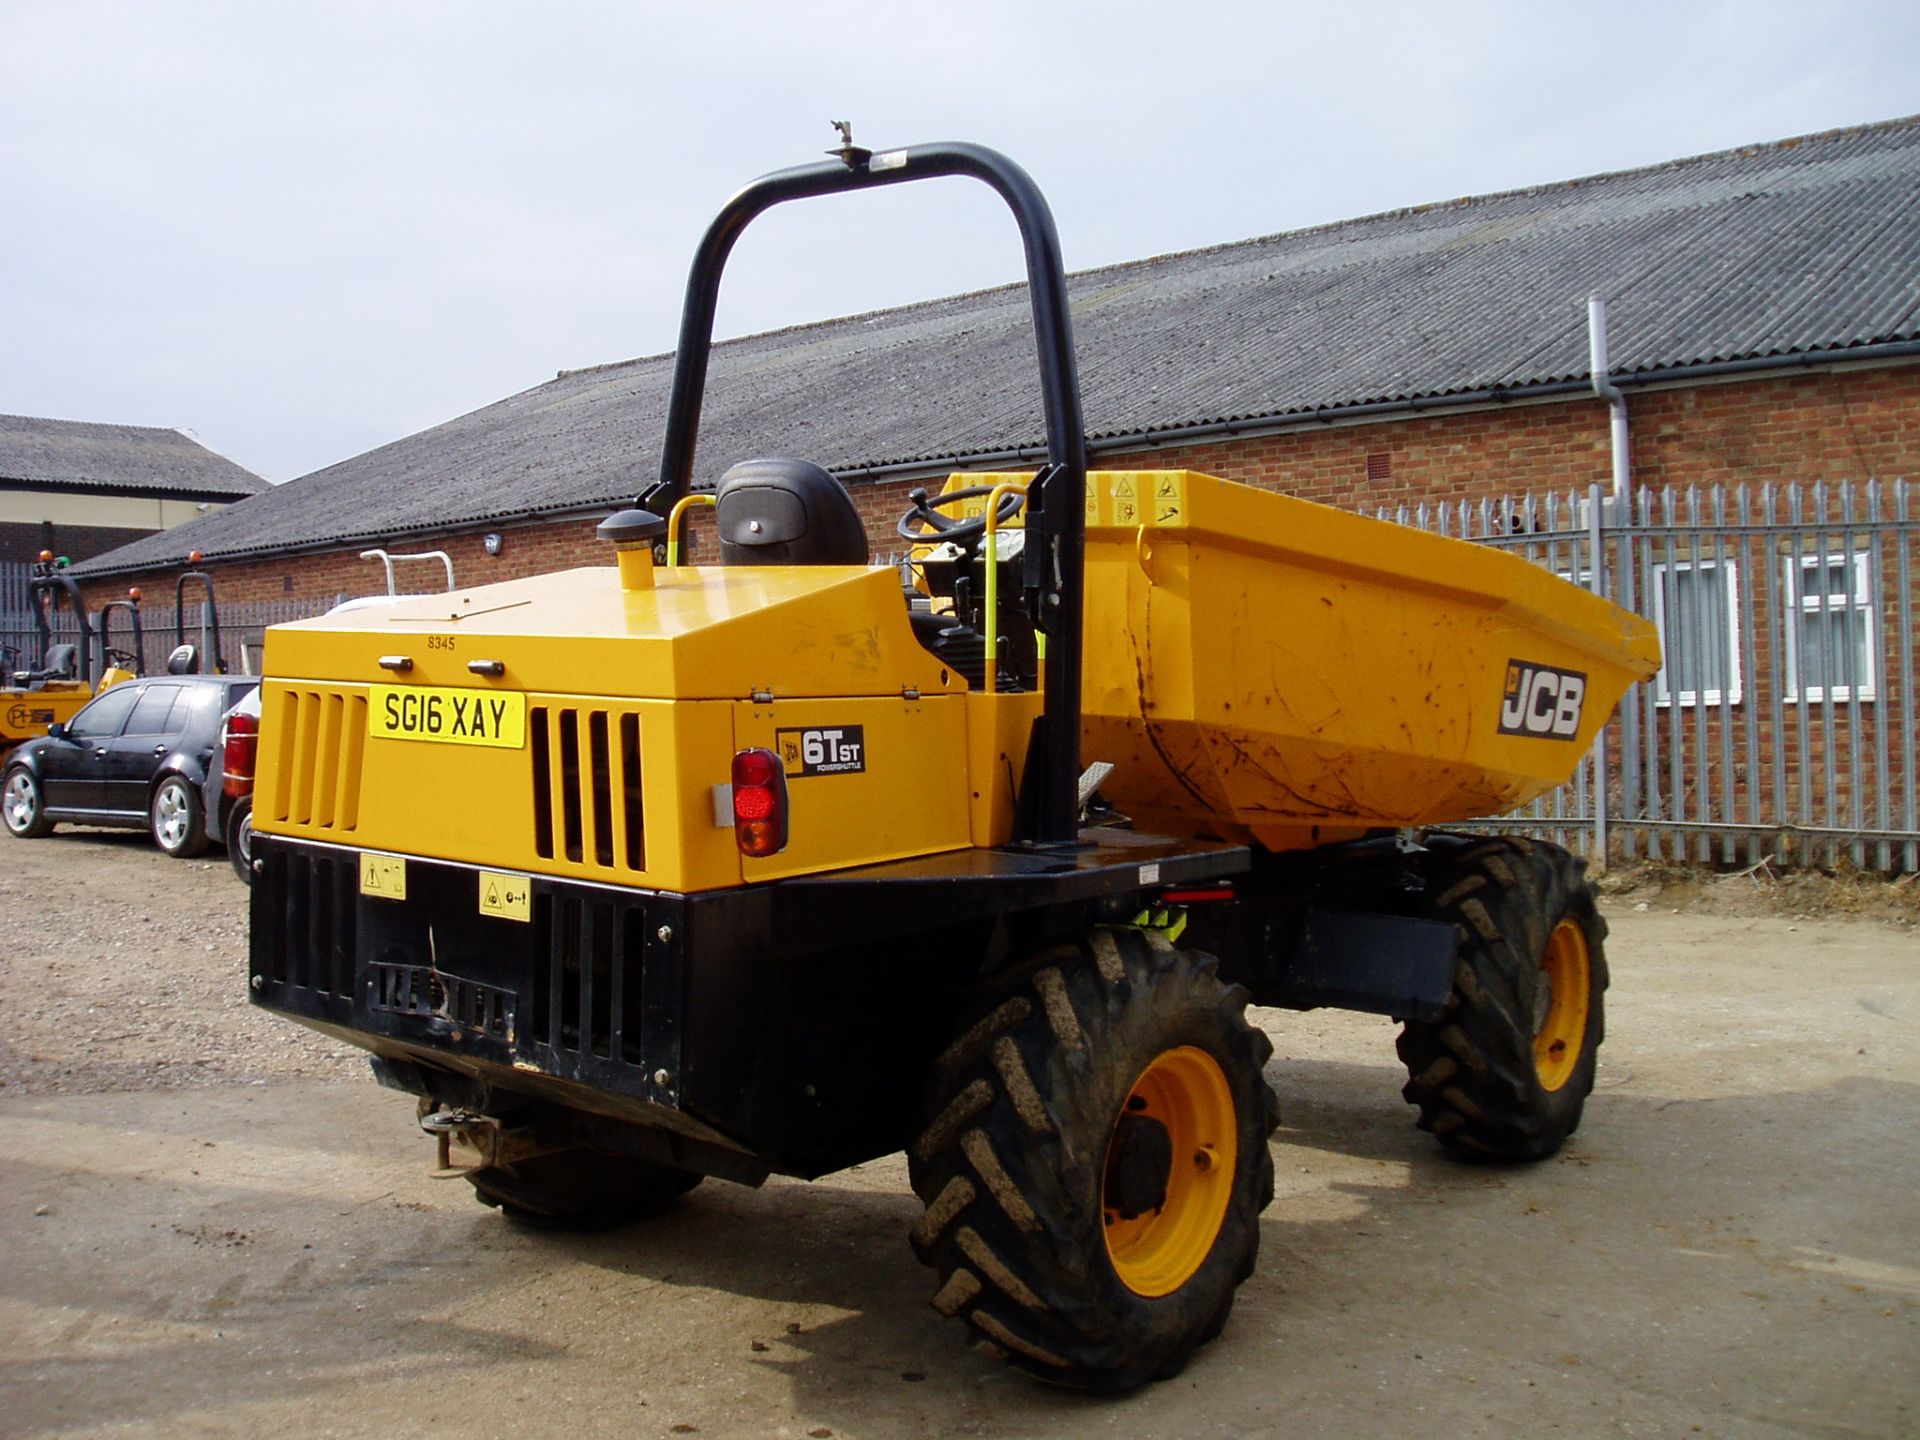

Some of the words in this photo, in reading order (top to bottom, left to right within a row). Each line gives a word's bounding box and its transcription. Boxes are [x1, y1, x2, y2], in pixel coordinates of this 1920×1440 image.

[428, 636, 455, 650] 8345
[385, 692, 442, 733] SG16
[451, 696, 506, 739] XAY
[1501, 668, 1584, 735] JCB
